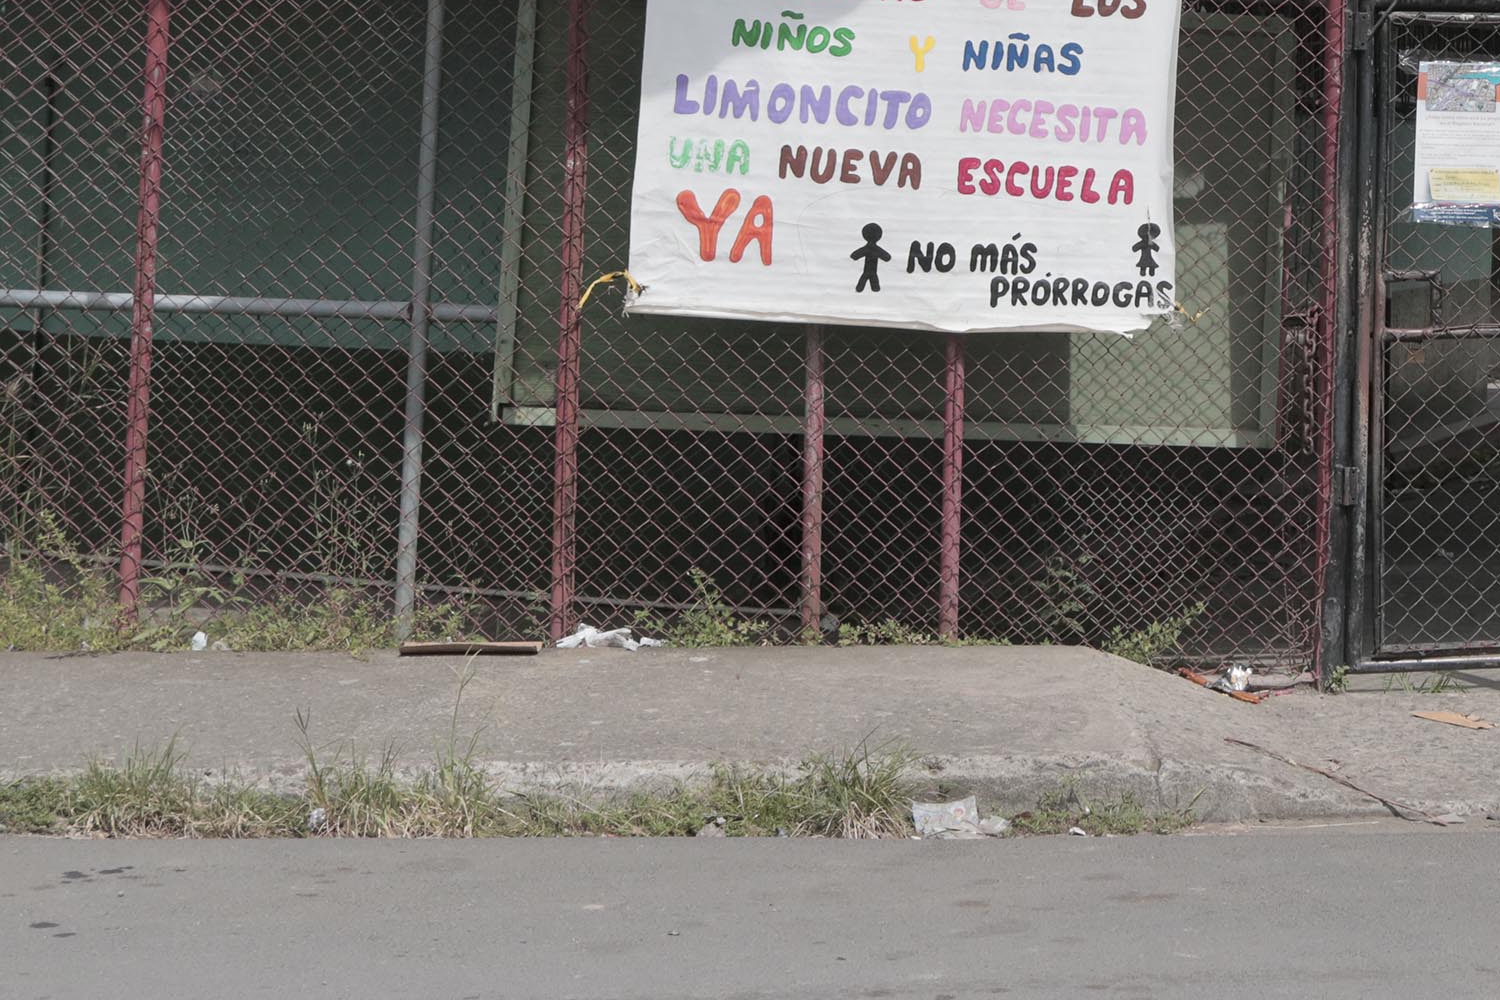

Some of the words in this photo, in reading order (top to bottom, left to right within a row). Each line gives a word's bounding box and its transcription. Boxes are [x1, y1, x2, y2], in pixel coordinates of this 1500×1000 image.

[732, 11, 855, 57] NIÑOS
[909, 35, 935, 72] Y
[963, 33, 1083, 76] NIÑAS
[673, 74, 932, 129] LIMONCITO
[960, 99, 1147, 145] NECESITA
[669, 136, 750, 175] UNA
[779, 145, 922, 189] NUEVA
[958, 158, 1134, 204] ESCUELA
[675, 188, 774, 266] YA
[907, 240, 954, 273] NO
[990, 272, 1173, 310] PRÓRROGAS
